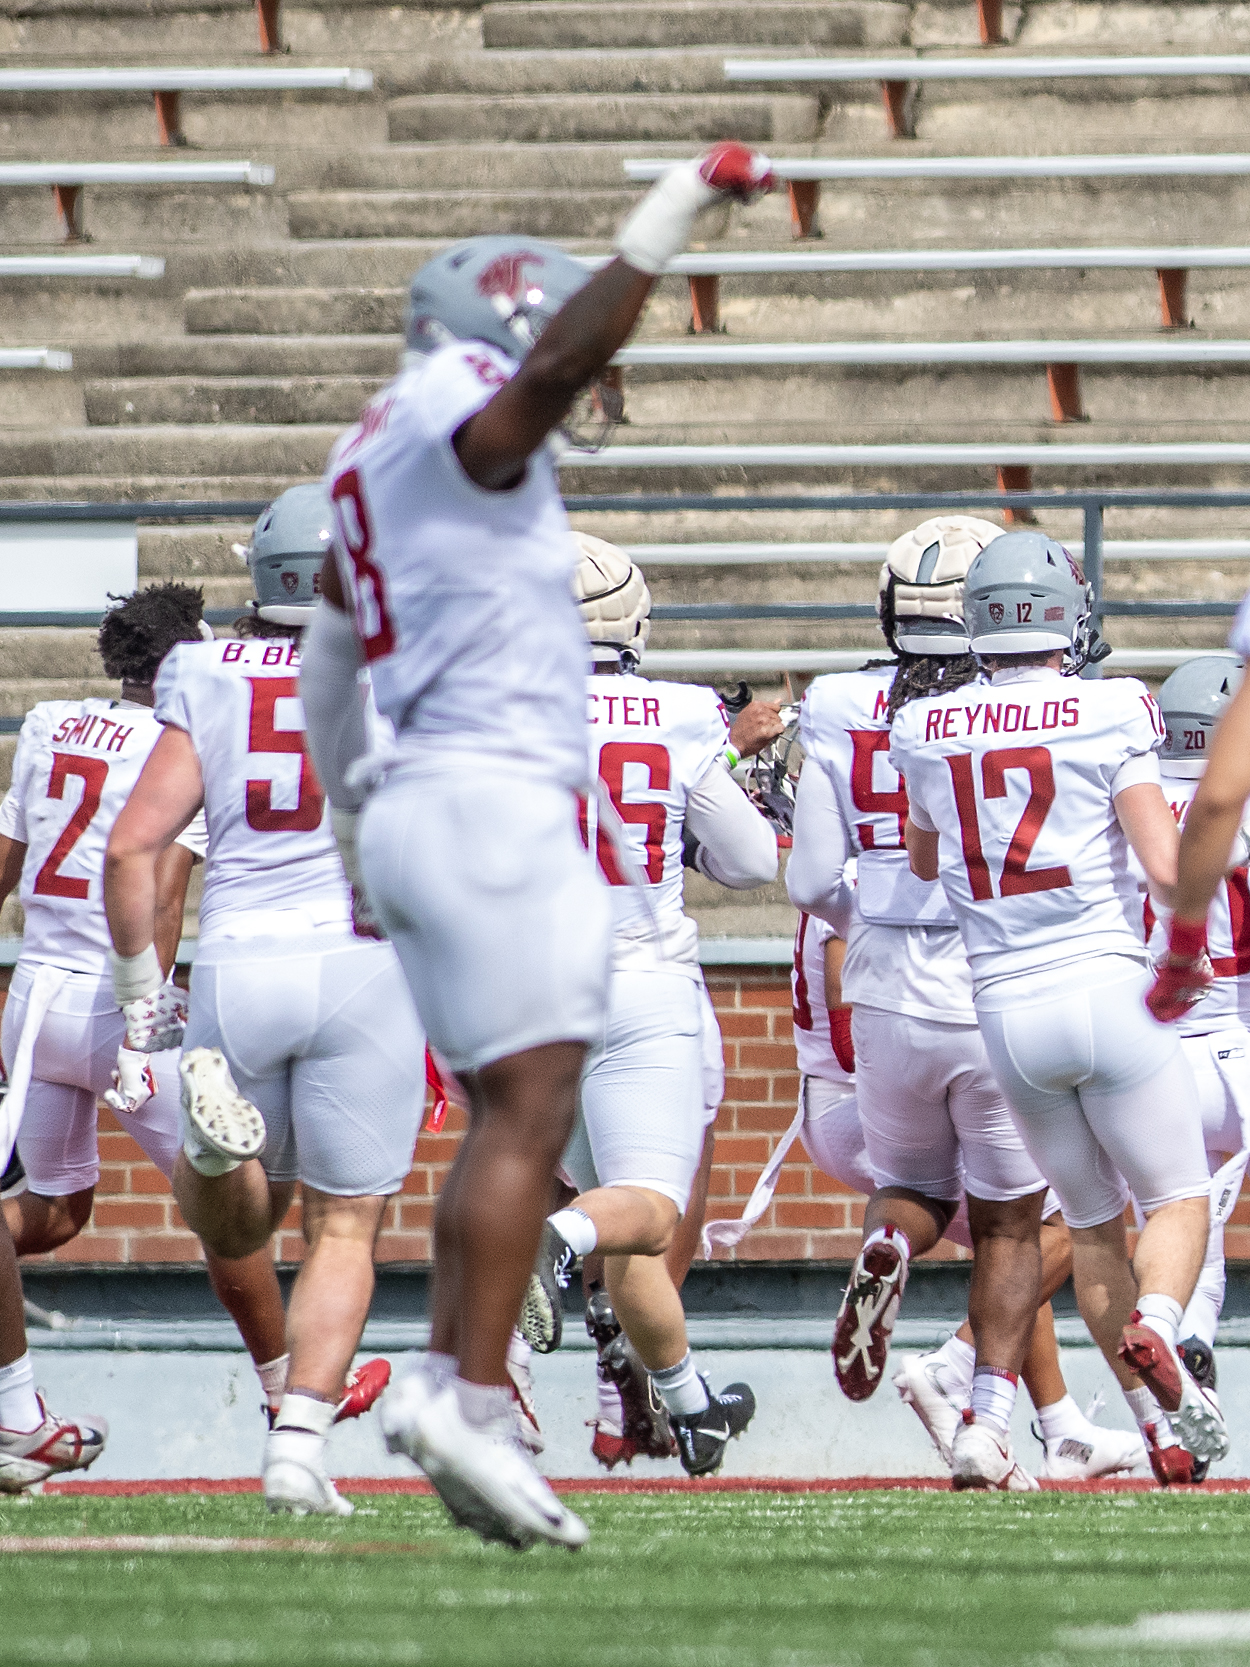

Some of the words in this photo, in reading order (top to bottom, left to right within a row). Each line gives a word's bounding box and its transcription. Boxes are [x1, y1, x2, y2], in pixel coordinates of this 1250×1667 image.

[1016, 602, 1032, 623] 12
[52, 713, 135, 752] SMITH
[925, 697, 1080, 742] REYNOLDS
[1183, 730, 1206, 750] 20
[34, 751, 109, 900] 2
[942, 746, 1073, 902] 12
